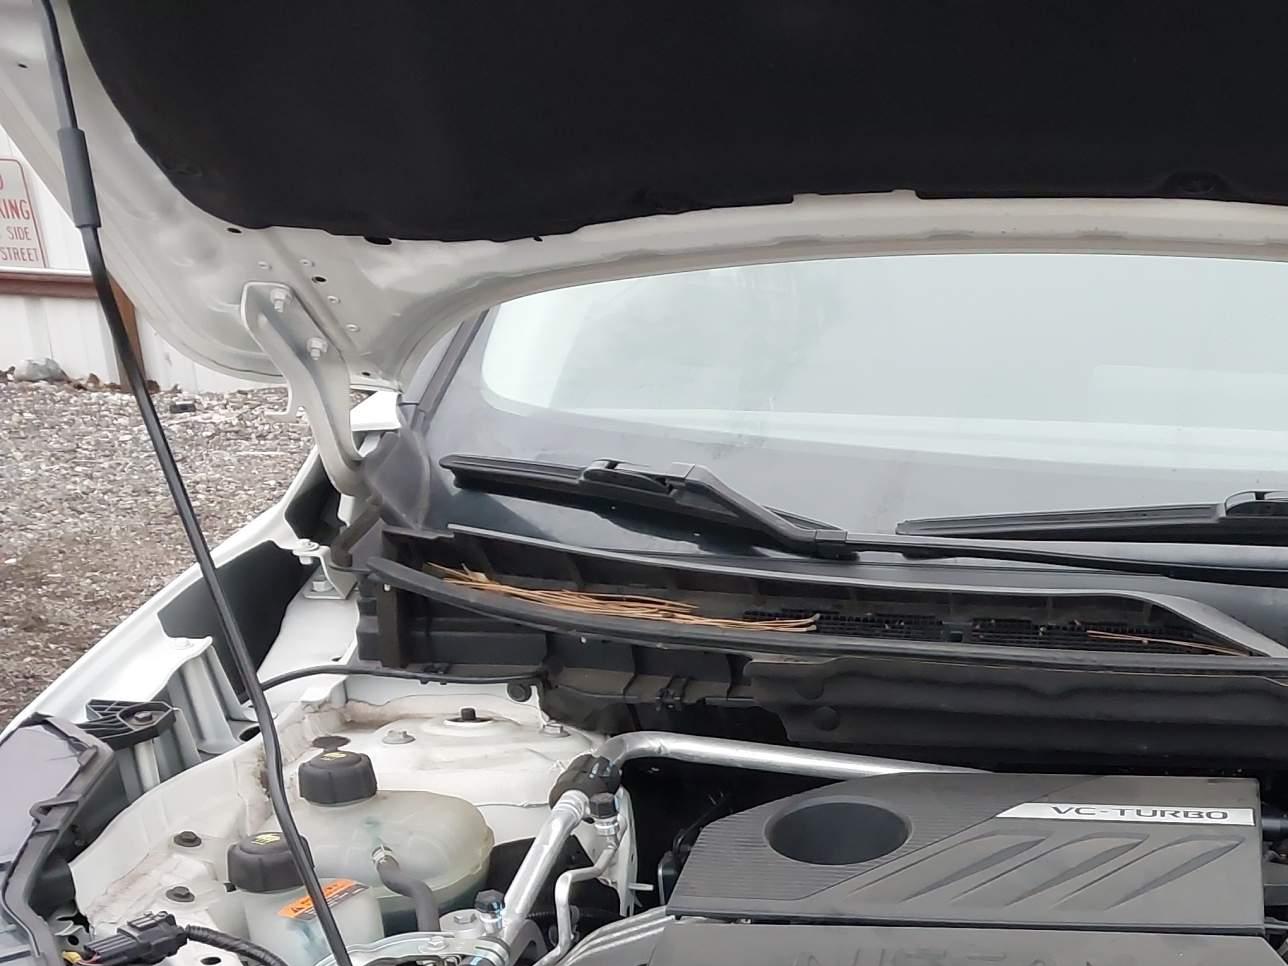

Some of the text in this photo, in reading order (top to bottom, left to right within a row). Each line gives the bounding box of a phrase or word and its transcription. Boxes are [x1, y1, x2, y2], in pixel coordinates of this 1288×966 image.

[6, 226, 32, 241] SIDE
[0, 247, 40, 262] STREET
[1050, 805, 1229, 821] VC-TURBO
